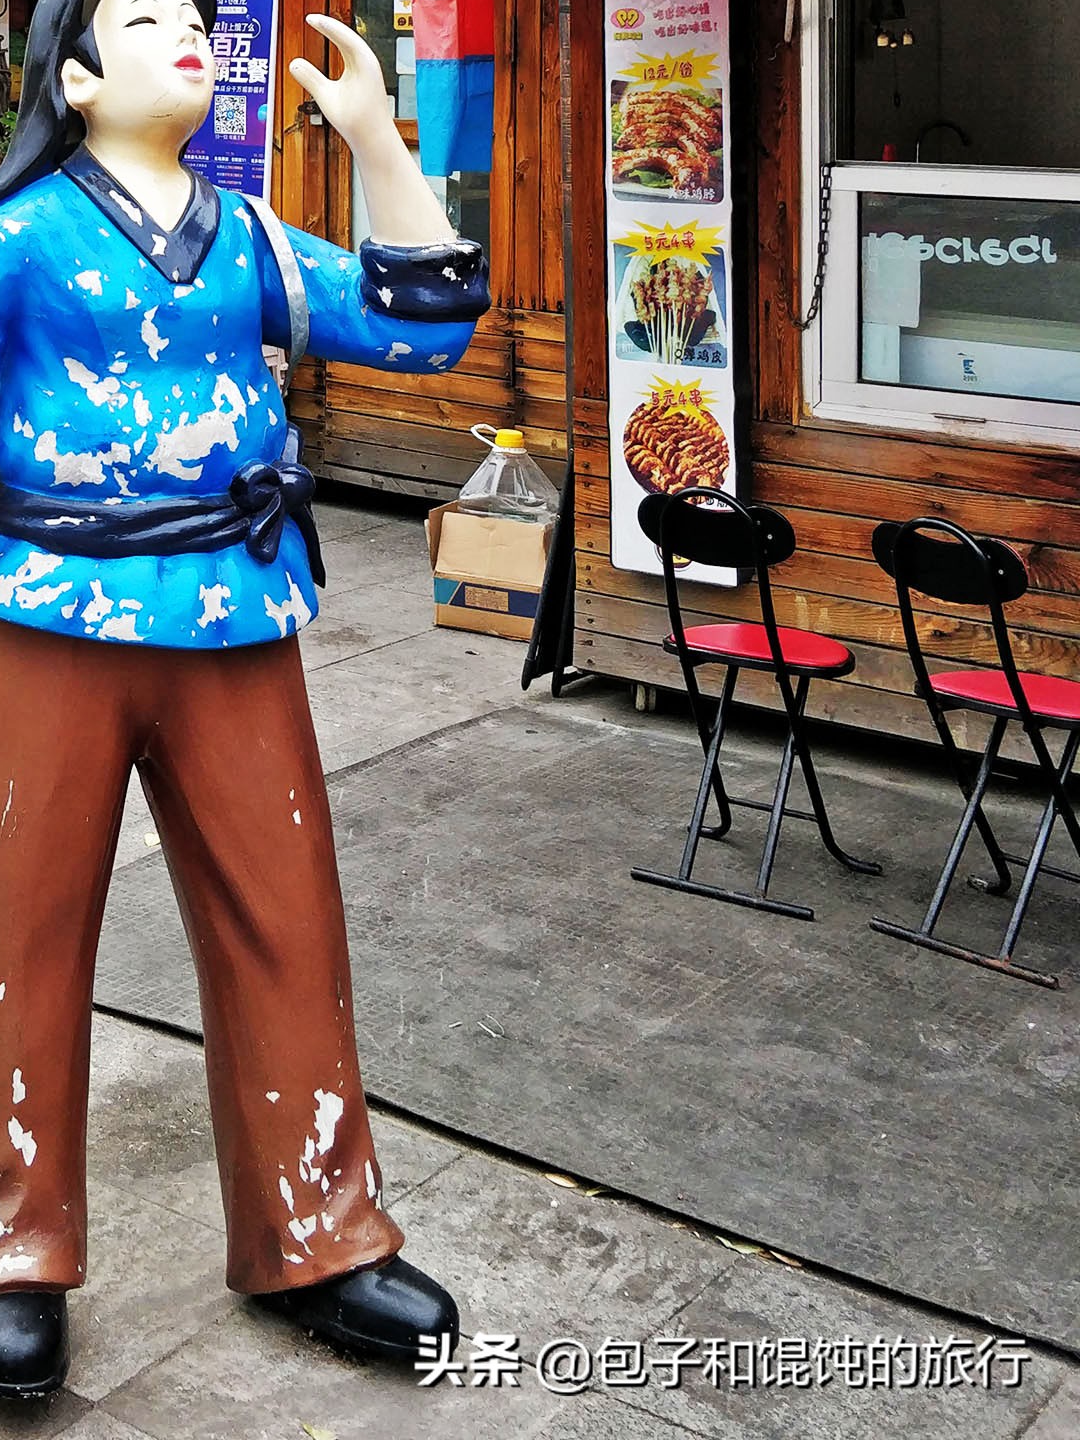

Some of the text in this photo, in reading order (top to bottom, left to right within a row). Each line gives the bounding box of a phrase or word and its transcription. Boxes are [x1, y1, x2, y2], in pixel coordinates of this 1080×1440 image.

[210, 33, 253, 57] 百万
[644, 230, 695, 252] 5元4串
[651, 388, 703, 407] 5元4串
